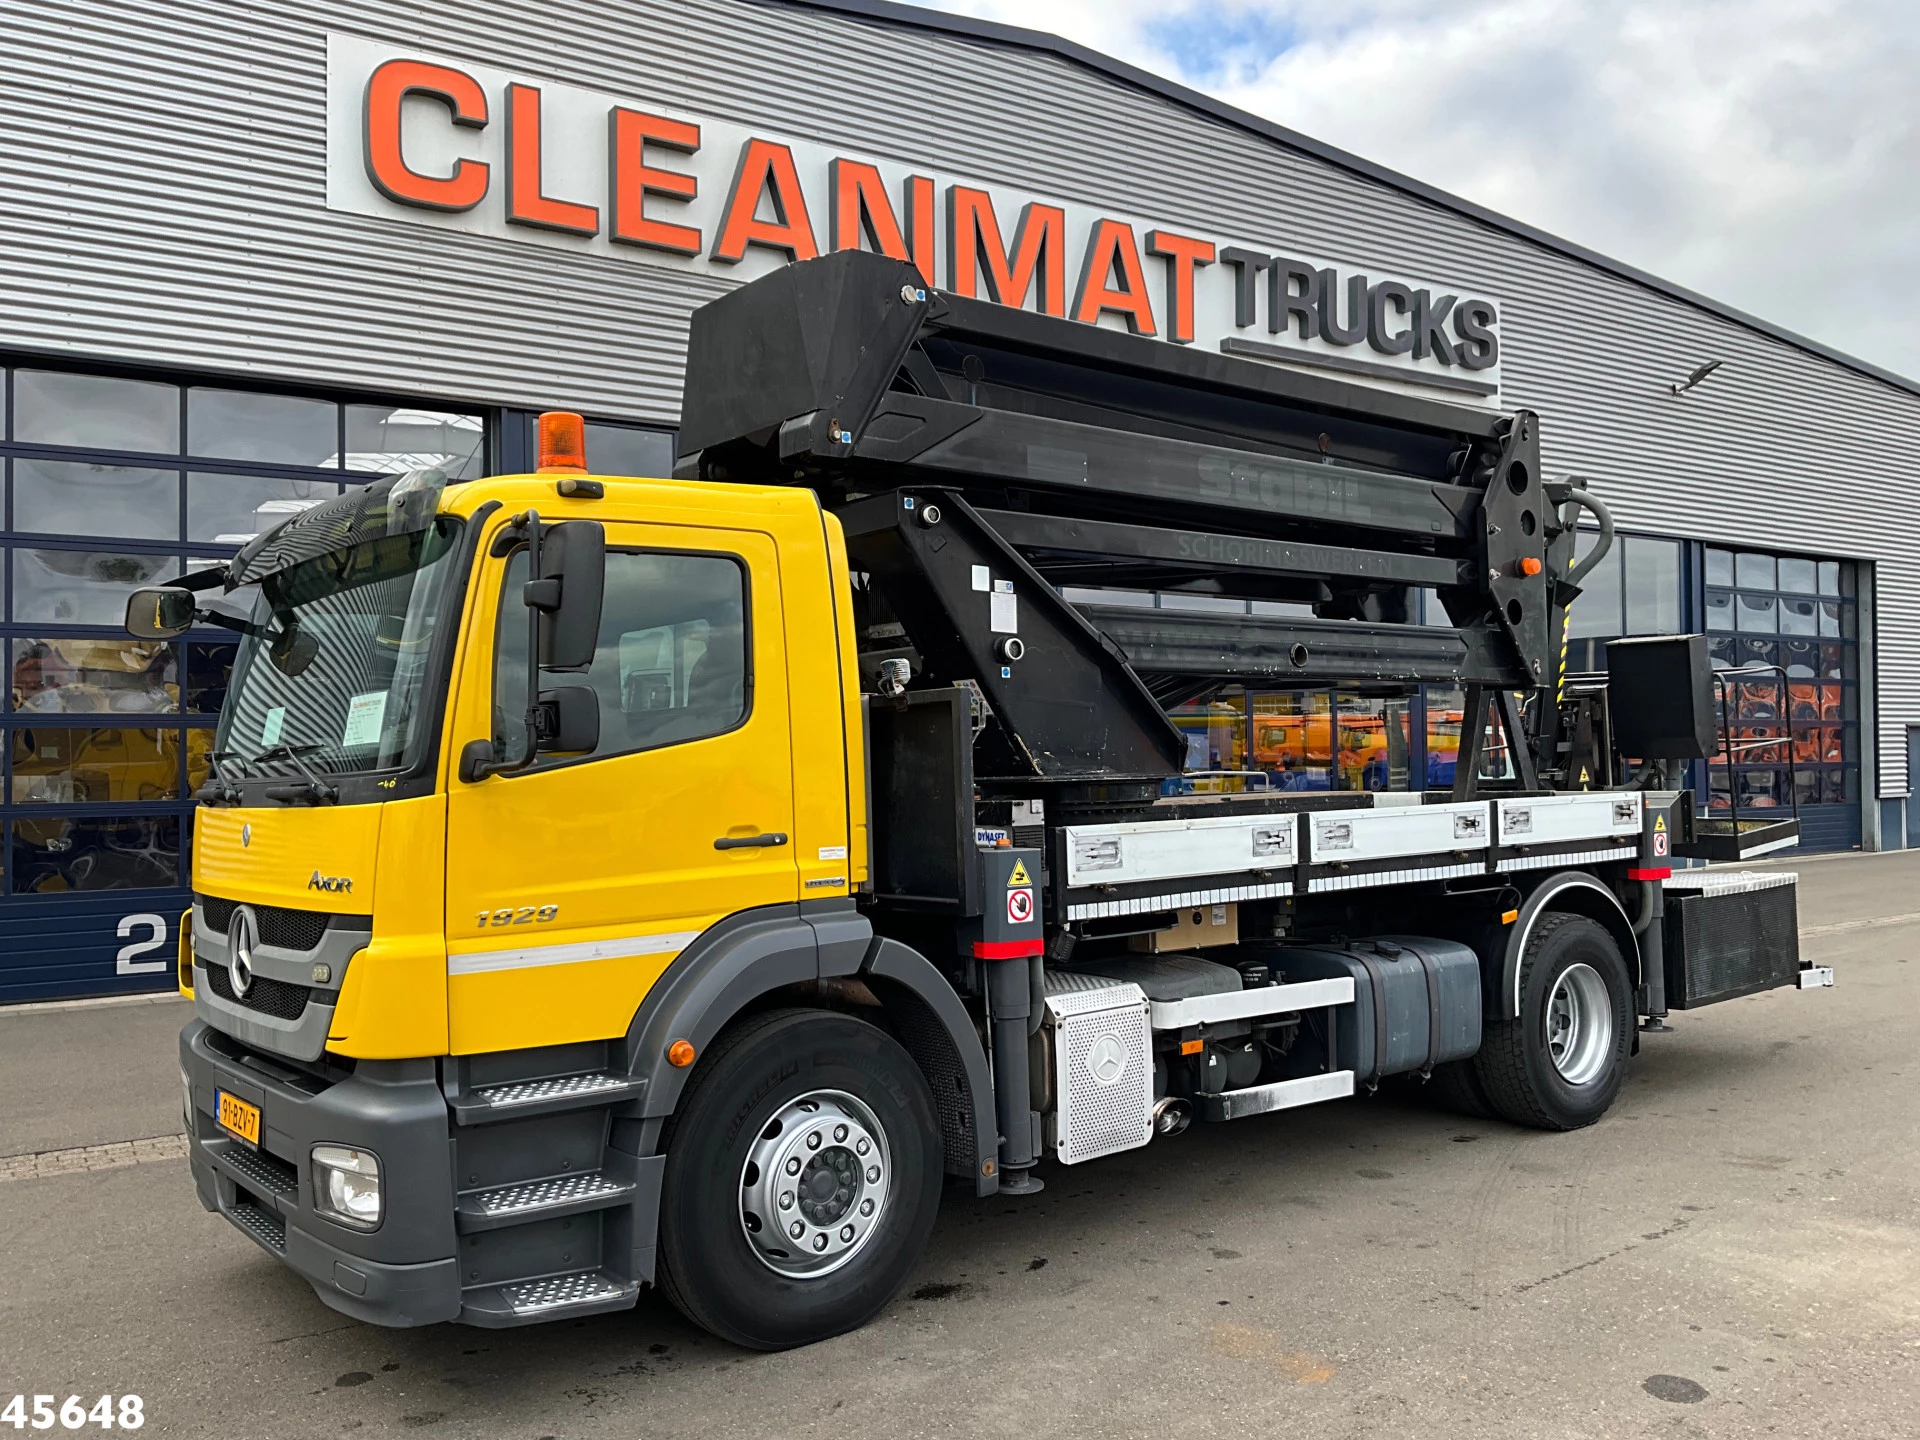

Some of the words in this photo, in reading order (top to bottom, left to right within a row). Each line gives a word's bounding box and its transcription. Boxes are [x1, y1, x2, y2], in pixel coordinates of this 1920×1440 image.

[362, 58, 1215, 345] CLEANMAT
[1220, 246, 1499, 371] TRUCKS
[978, 830, 1005, 844] DYNASET
[475, 905, 558, 928] 1929
[116, 913, 167, 975] 2
[223, 1099, 256, 1137] 91-BZV-7
